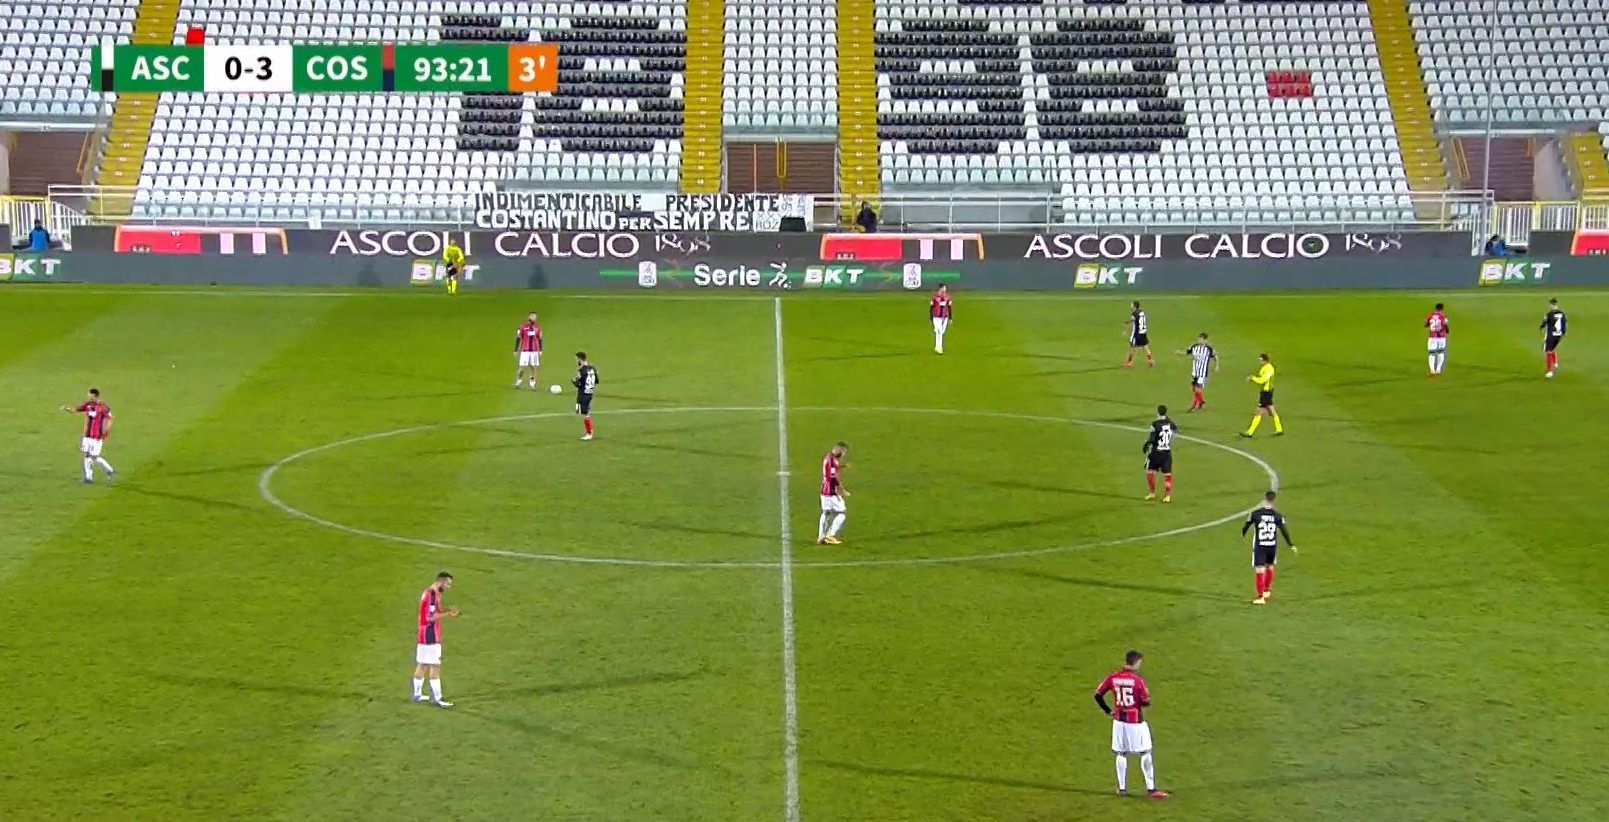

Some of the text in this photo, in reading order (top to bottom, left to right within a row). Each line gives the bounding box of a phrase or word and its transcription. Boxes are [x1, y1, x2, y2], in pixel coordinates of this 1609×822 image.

[475, 193, 641, 211] INDIMENTICABILE
[666, 194, 779, 212] PRESIDENTE
[476, 209, 616, 231] COSTANTINO
[619, 216, 651, 231] PER
[653, 210, 750, 231] SEMPRE
[494, 231, 640, 258] CALCIO
[1024, 233, 1162, 259] ASCOLI
[1184, 232, 1330, 259] CALCIO
[694, 263, 864, 287] Serie BKT
[1075, 265, 1143, 285] BKT
[1481, 262, 1550, 281] BKT
[1257, 521, 1277, 540] 29
[1114, 686, 1135, 707] 16
